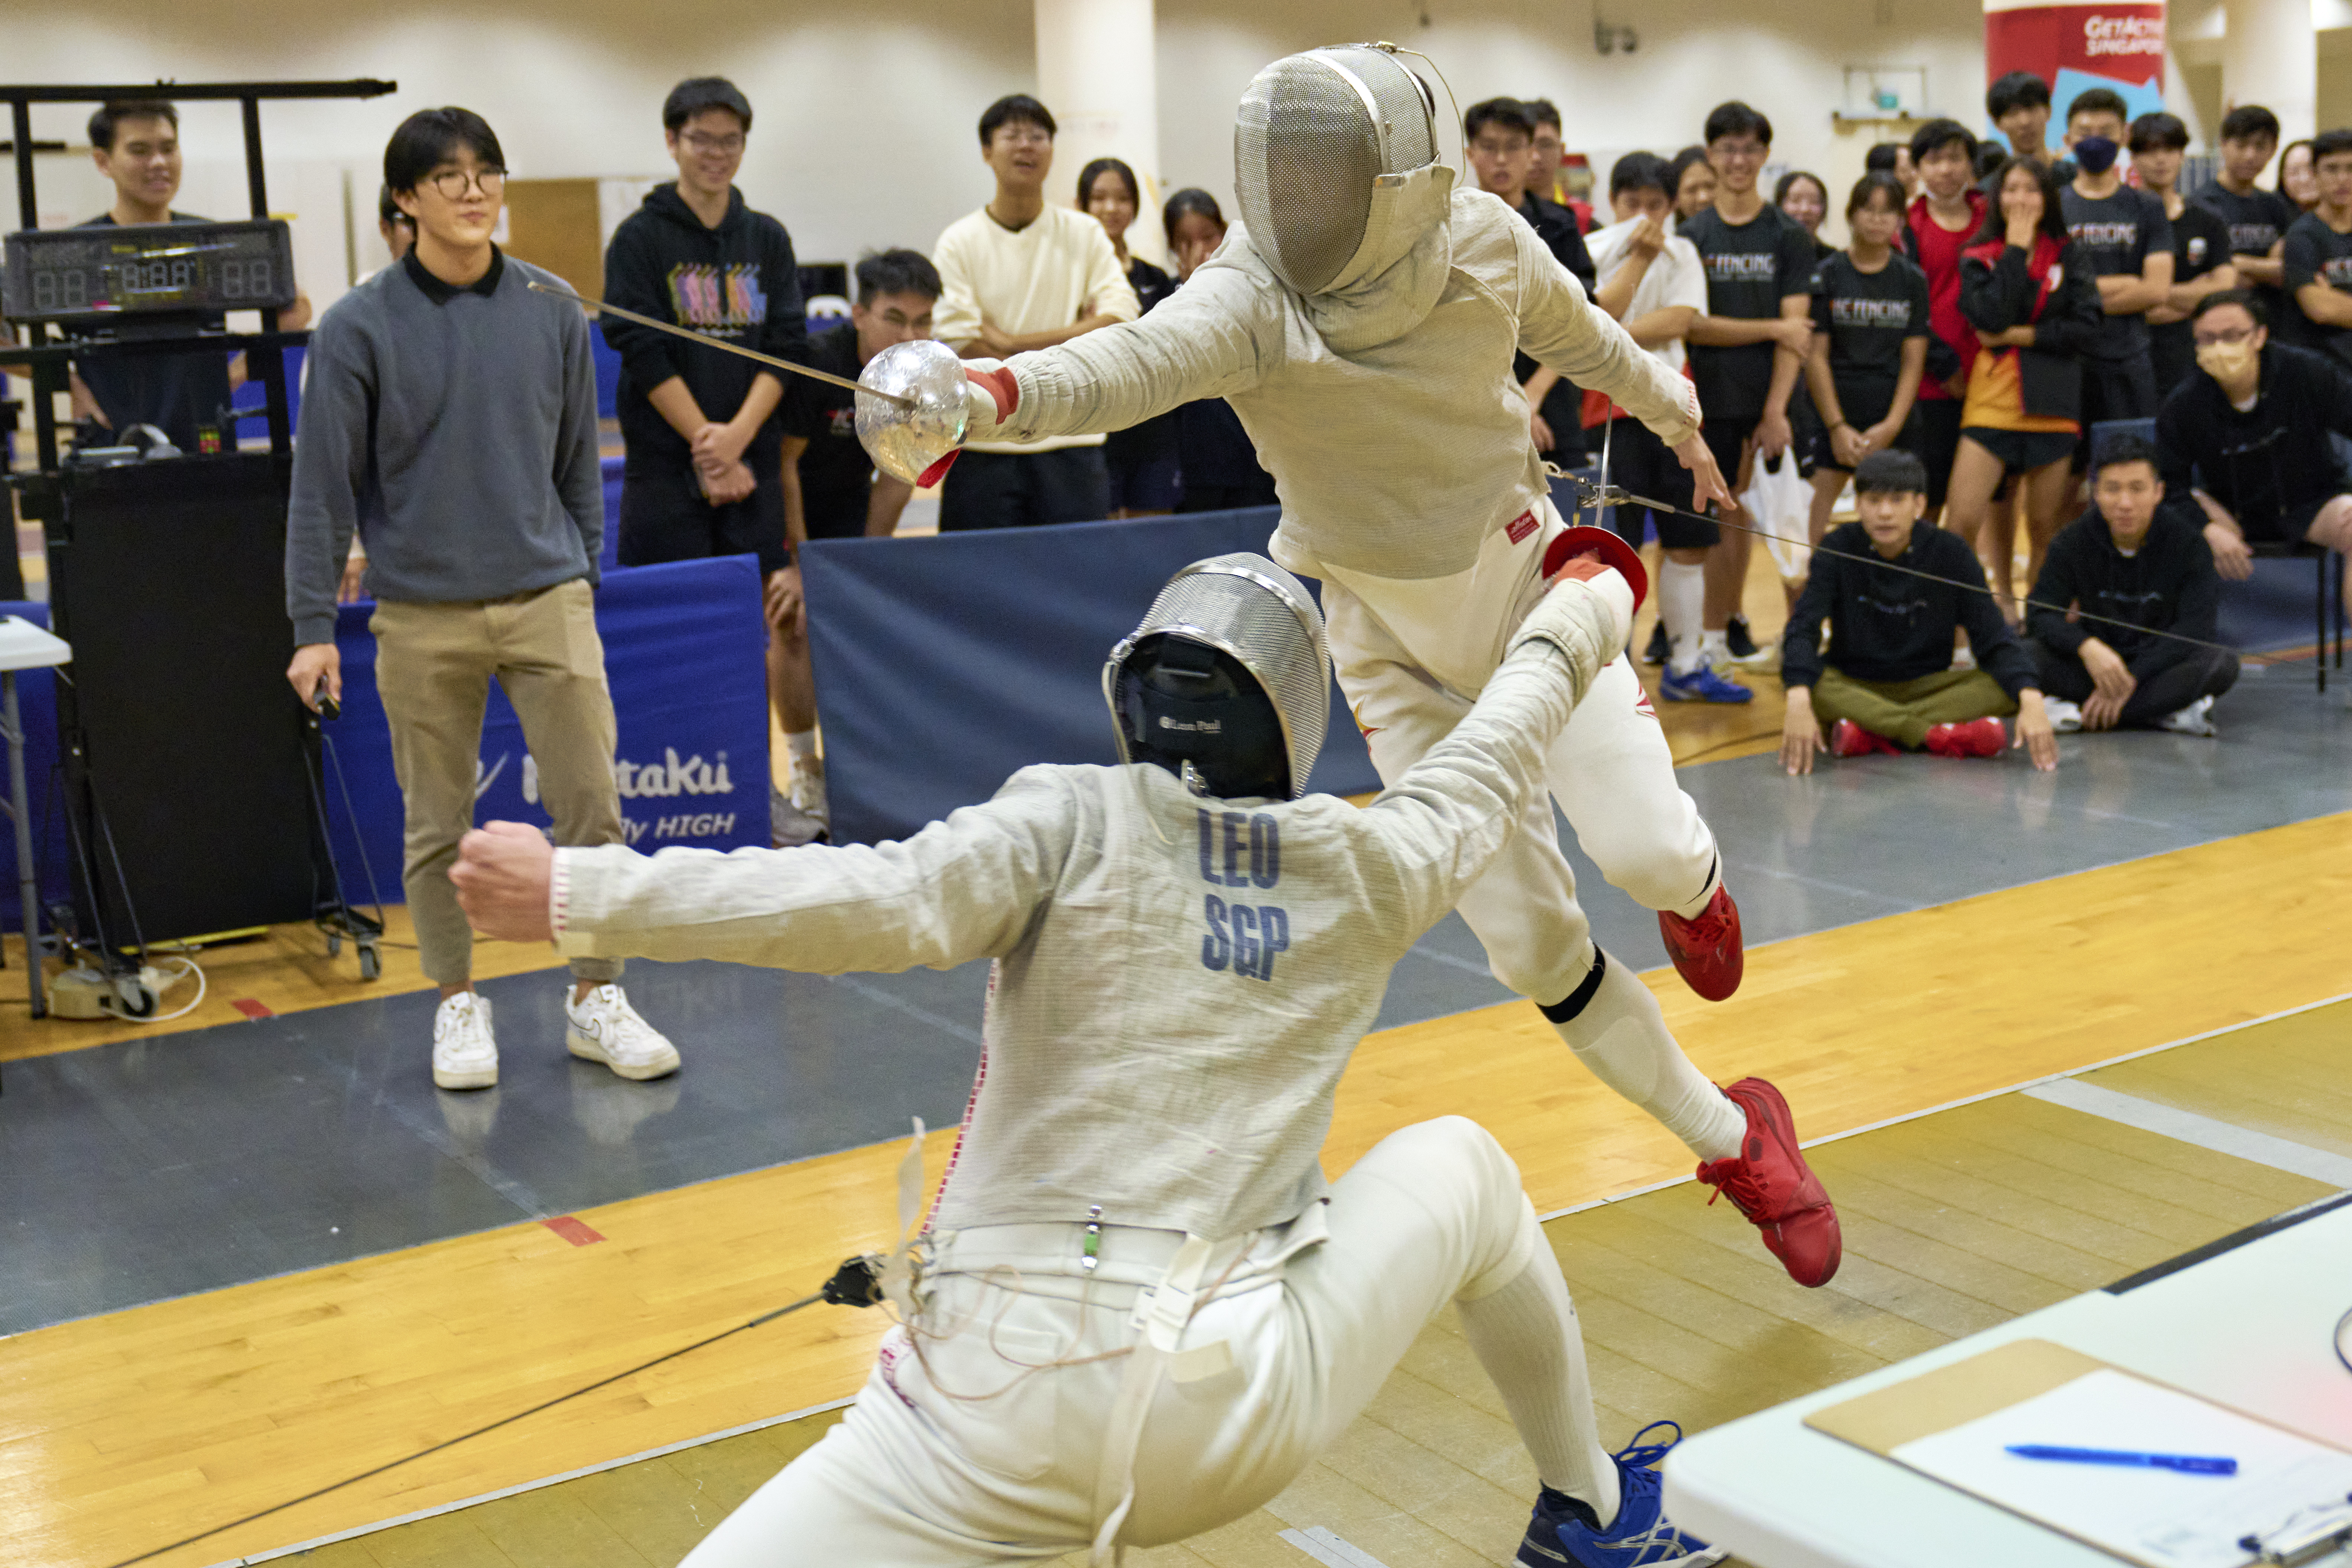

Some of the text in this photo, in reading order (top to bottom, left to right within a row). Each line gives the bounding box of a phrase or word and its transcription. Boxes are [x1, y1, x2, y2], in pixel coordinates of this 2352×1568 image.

[1197, 719, 1221, 731] Paul
[654, 813, 735, 839] HIGH
[1197, 809, 1281, 889] LEO
[1201, 894, 1290, 982] SGP
